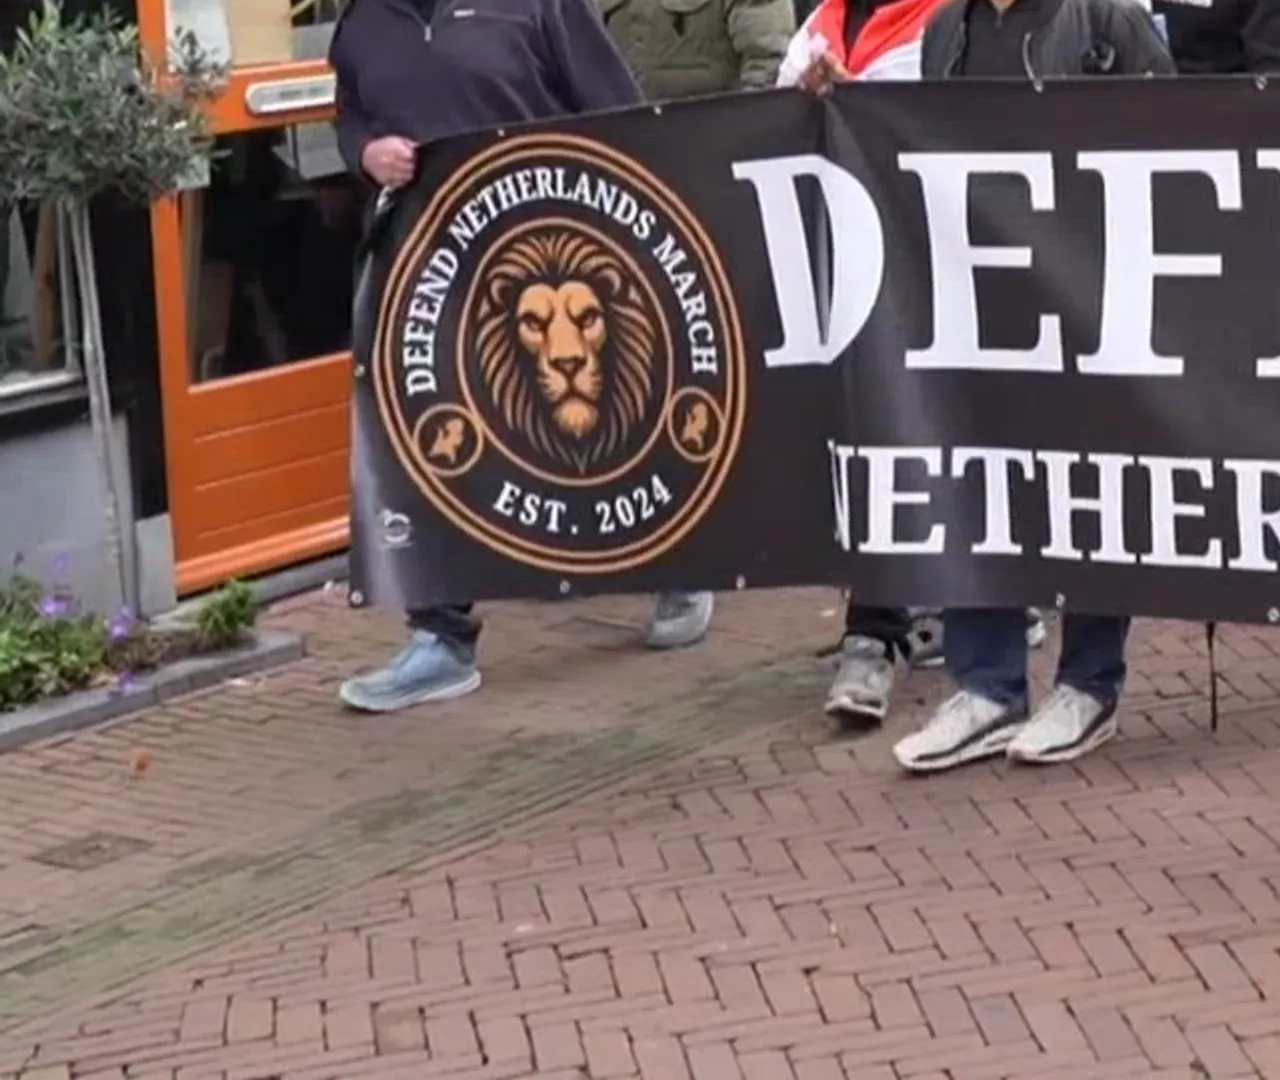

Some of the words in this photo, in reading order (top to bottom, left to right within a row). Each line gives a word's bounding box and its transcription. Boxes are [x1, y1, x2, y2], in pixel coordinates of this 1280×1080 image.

[403, 251, 460, 396] DEFEND
[453, 167, 657, 251] NETHERLANDS
[651, 233, 718, 375] MARCH
[492, 480, 579, 535] EST.
[595, 473, 673, 533] 2024
